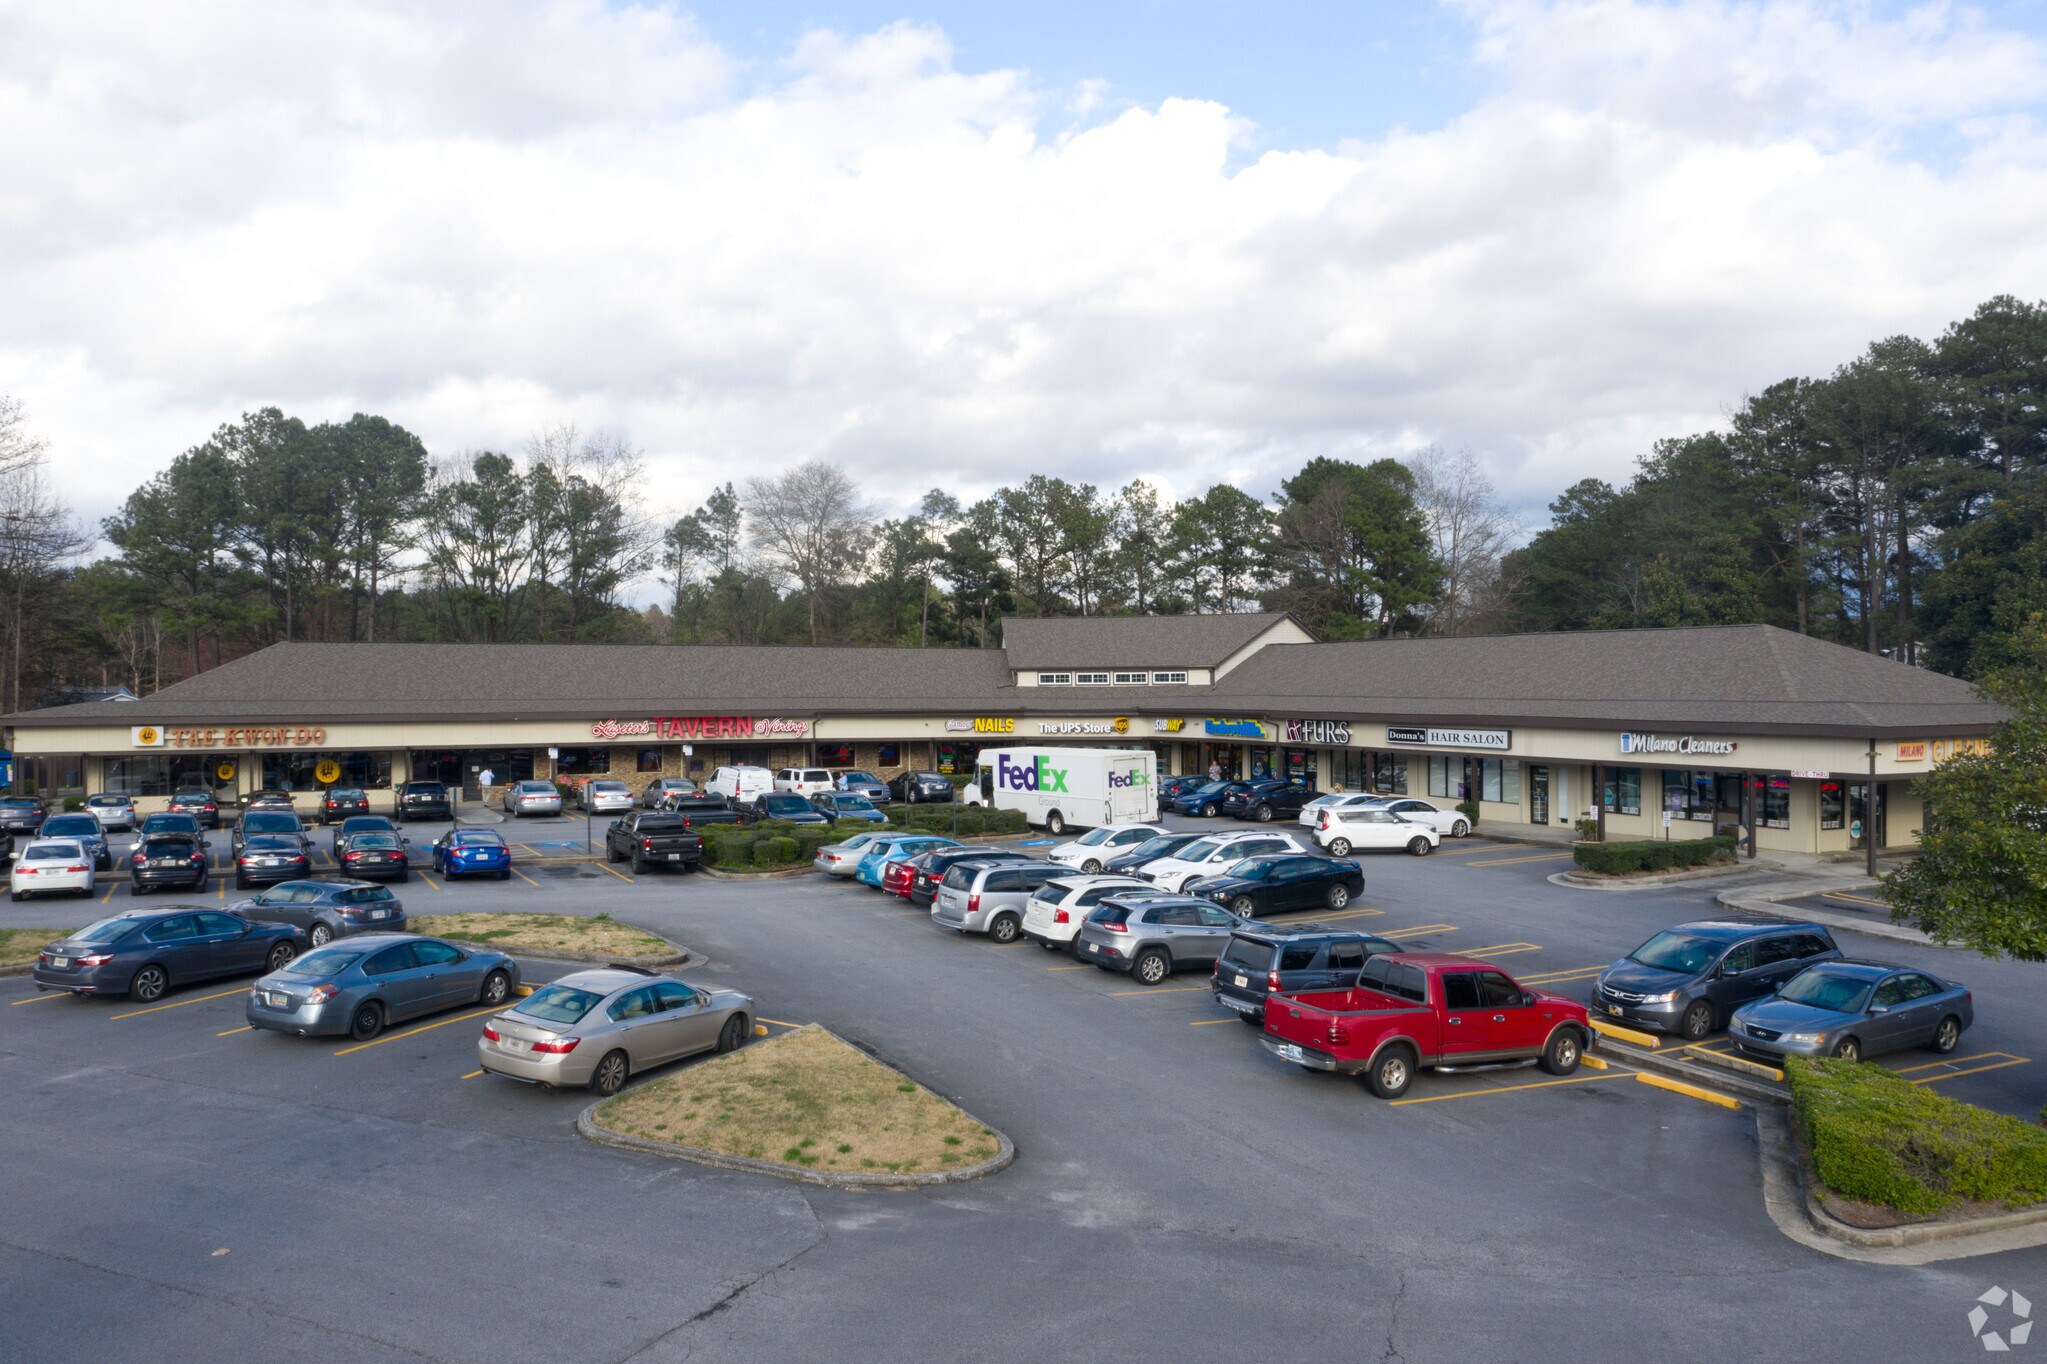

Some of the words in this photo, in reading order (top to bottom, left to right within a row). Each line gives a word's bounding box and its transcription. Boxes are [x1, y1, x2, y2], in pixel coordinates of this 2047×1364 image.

[592, 718, 649, 738] Laseter's
[652, 716, 752, 738] TAVERN
[975, 718, 1015, 732] NAILS
[1038, 722, 1058, 734] The
[1059, 722, 1081, 734] UPS
[1083, 722, 1111, 734] Store
[1154, 719, 1184, 732] SUBWAY
[1303, 720, 1349, 744] FURS
[172, 728, 215, 746] TAE
[223, 727, 288, 746] KWON
[293, 727, 326, 745] DO
[1389, 730, 1425, 741] Donna's
[1430, 732, 1461, 743] HAIR
[1463, 733, 1505, 745] SALON
[1631, 733, 1677, 752] Milano
[1678, 735, 1734, 754] Cleaners
[1900, 745, 1925, 758] MILANO
[998, 753, 1069, 793] FedEx
[1108, 768, 1152, 789] FedEx
[1038, 796, 1061, 808] Ground
